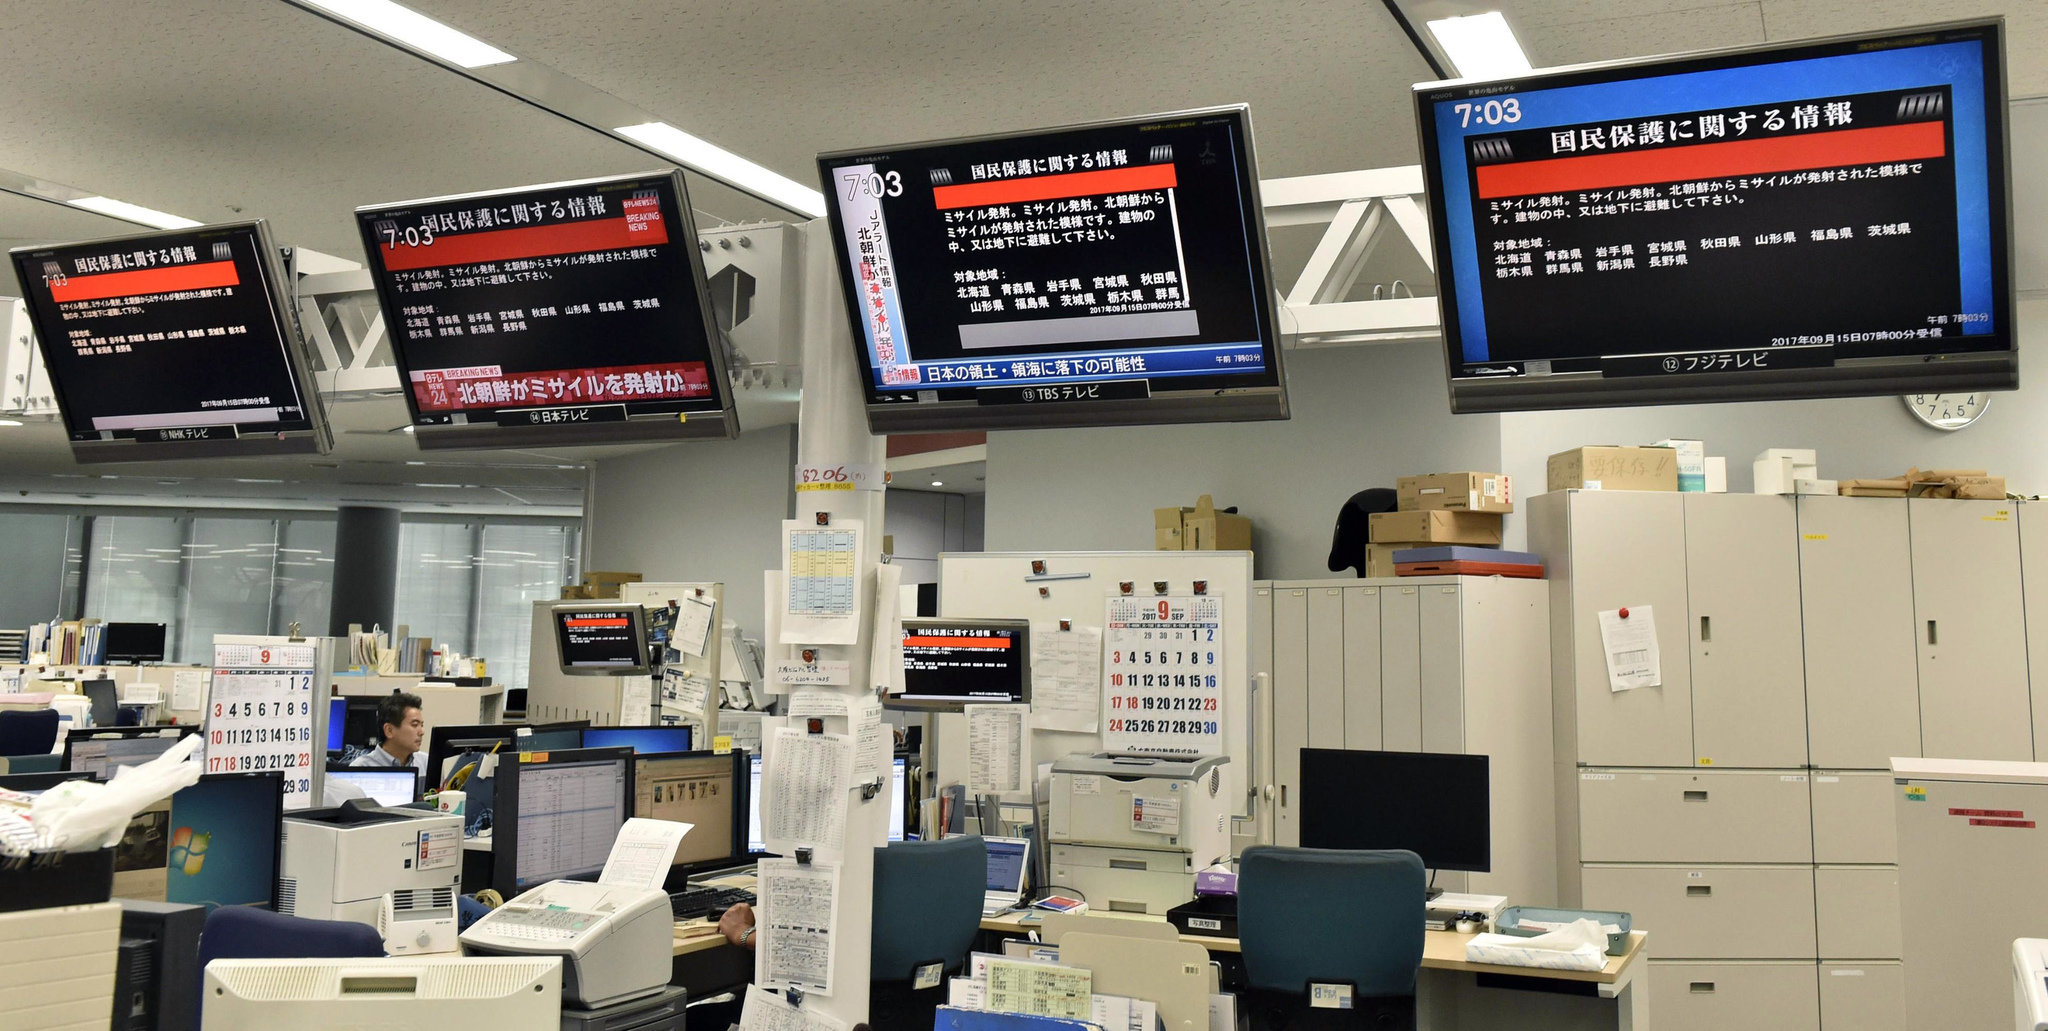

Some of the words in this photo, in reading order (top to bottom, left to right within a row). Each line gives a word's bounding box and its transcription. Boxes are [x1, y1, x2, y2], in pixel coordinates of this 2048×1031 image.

[1454, 98, 1522, 128] 7:03
[1551, 101, 1853, 154] 国民保護に関する情報
[971, 149, 1129, 181] 国民保護に関する情報
[843, 170, 903, 201] 7:03
[1490, 163, 1923, 212] ミサイル発射。ミサイル発射。北朝鮮からミサイルが発射された模様で
[420, 195, 607, 234] 国民保護に関する情報
[944, 191, 1165, 224] ミサイル発射。ミサイル発射。北朝鮮から
[1490, 198, 1746, 226] す。建物の中、又は地下に避難して下さい。
[626, 212, 660, 223] BREAKING
[947, 208, 1156, 239] ミサイルが発射された模様です。建物の
[629, 222, 649, 233] NEWS
[382, 225, 435, 250] 7:03
[948, 228, 1117, 254] 中、又は地下に避難して下さい。
[1495, 252, 1532, 265] 北海道
[1544, 248, 1583, 262] 青森県
[1595, 244, 1634, 258] 岩手県
[1647, 240, 1687, 254] 宮城県
[1700, 235, 1741, 250] 秋田県
[1755, 231, 1797, 246] 山形県
[1810, 227, 1854, 241] 福島県
[1868, 222, 1912, 238] 茨城県
[74, 245, 198, 274] 国民保護に関する情報
[394, 248, 658, 282] ミサイル発射。ミサイル発射。北朝鮮からミサイルが発射された模様で
[1496, 264, 1534, 279] 栃木県
[1545, 260, 1584, 275] 群馬県
[1596, 256, 1635, 271] 新潟県
[1648, 254, 1689, 268] 長野県
[42, 273, 68, 288] 7:03
[957, 285, 992, 299] 北海道
[1001, 282, 1036, 296] 青森県
[1046, 278, 1082, 292] 岩手県
[1093, 274, 1130, 290] 宮城県
[1140, 270, 1178, 286] 秋田県
[970, 299, 1005, 313] 山形県
[1014, 296, 1050, 310] 福島県
[1060, 292, 1097, 307] 茨城県
[1106, 288, 1144, 304] 栃木県
[1155, 287, 1180, 301] 群馬
[531, 307, 558, 318] 秋田県
[564, 304, 592, 315] 山形県
[1926, 314, 1948, 325] 午前
[1951, 312, 1989, 324] 7時03分
[502, 321, 528, 332] 長野県
[1771, 328, 1943, 347] 2017年09月15日07時00分受信
[1215, 354, 1231, 364] 午前
[1684, 352, 1769, 371] フジテレビ
[446, 368, 481, 379] BREAKING
[480, 366, 500, 377] NEWS
[926, 355, 1147, 383] 日本の領土・領海に落下の可能性
[457, 370, 684, 404] 北朝鮮がミサイルを発射か
[1036, 386, 1059, 401] TBS
[1063, 384, 1100, 400] テレビ
[431, 391, 449, 405] 24
[1915, 393, 1925, 406] 8
[1966, 394, 1976, 406] 4
[541, 408, 590, 423] 日本テレビ
[1929, 404, 1937, 417] 7
[1942, 407, 1951, 421] 6
[1957, 405, 1966, 418] 5
[168, 429, 186, 440] NHK
[185, 428, 209, 440] テレビ
[802, 466, 848, 483] 8206
[1142, 613, 1156, 621] 2017
[1171, 613, 1184, 621] SEP
[1157, 600, 1169, 620] 9
[1192, 629, 1198, 641] 1
[1206, 629, 1214, 641] 2
[261, 650, 271, 663] 9
[1113, 651, 1121, 663] 3
[1129, 651, 1136, 664] 4
[1144, 652, 1151, 664] 5
[1160, 651, 1167, 664] 6
[1175, 652, 1182, 664] 7
[1191, 652, 1198, 664] 8
[1206, 652, 1214, 665] 9
[290, 677, 295, 690] 1
[302, 677, 309, 690] 2
[1111, 673, 1123, 686] 10
[1127, 674, 1138, 686] 11
[1142, 674, 1154, 687] 12
[1157, 674, 1170, 687] 13
[1173, 675, 1185, 687] 14
[1188, 675, 1201, 687] 15
[1204, 675, 1216, 688] 16
[214, 703, 222, 718] 3
[229, 703, 237, 717] 4
[244, 703, 252, 717] 5
[258, 702, 266, 717] 6
[274, 702, 281, 716] 7
[287, 702, 294, 716] 8
[301, 702, 308, 715] 9
[1111, 696, 1122, 709] 17
[1126, 697, 1138, 709] 18
[1141, 697, 1154, 710] 19
[1156, 697, 1171, 710] 20
[1173, 698, 1185, 710] 21
[1188, 698, 1201, 711] 22
[1203, 698, 1217, 711] 23
[1109, 719, 1123, 731] 24
[1125, 719, 1139, 732] 25
[1140, 720, 1155, 733] 26
[1157, 720, 1170, 733] 27
[1172, 721, 1186, 734] 28
[1188, 721, 1202, 734] 29
[1203, 722, 1217, 734] 30
[211, 730, 223, 745] 10
[226, 729, 237, 744] 11
[240, 729, 252, 744] 12
[256, 728, 267, 743] 13
[270, 728, 281, 742] 14
[285, 728, 296, 741] 15
[299, 727, 310, 741] 16
[209, 757, 221, 772] 17
[224, 757, 236, 771] 18
[240, 756, 251, 770] 19
[254, 755, 266, 769] 20
[270, 754, 281, 768] 21
[284, 754, 296, 767] 22
[298, 753, 310, 767] 23
[283, 780, 295, 794] 29
[298, 779, 309, 792] 30
